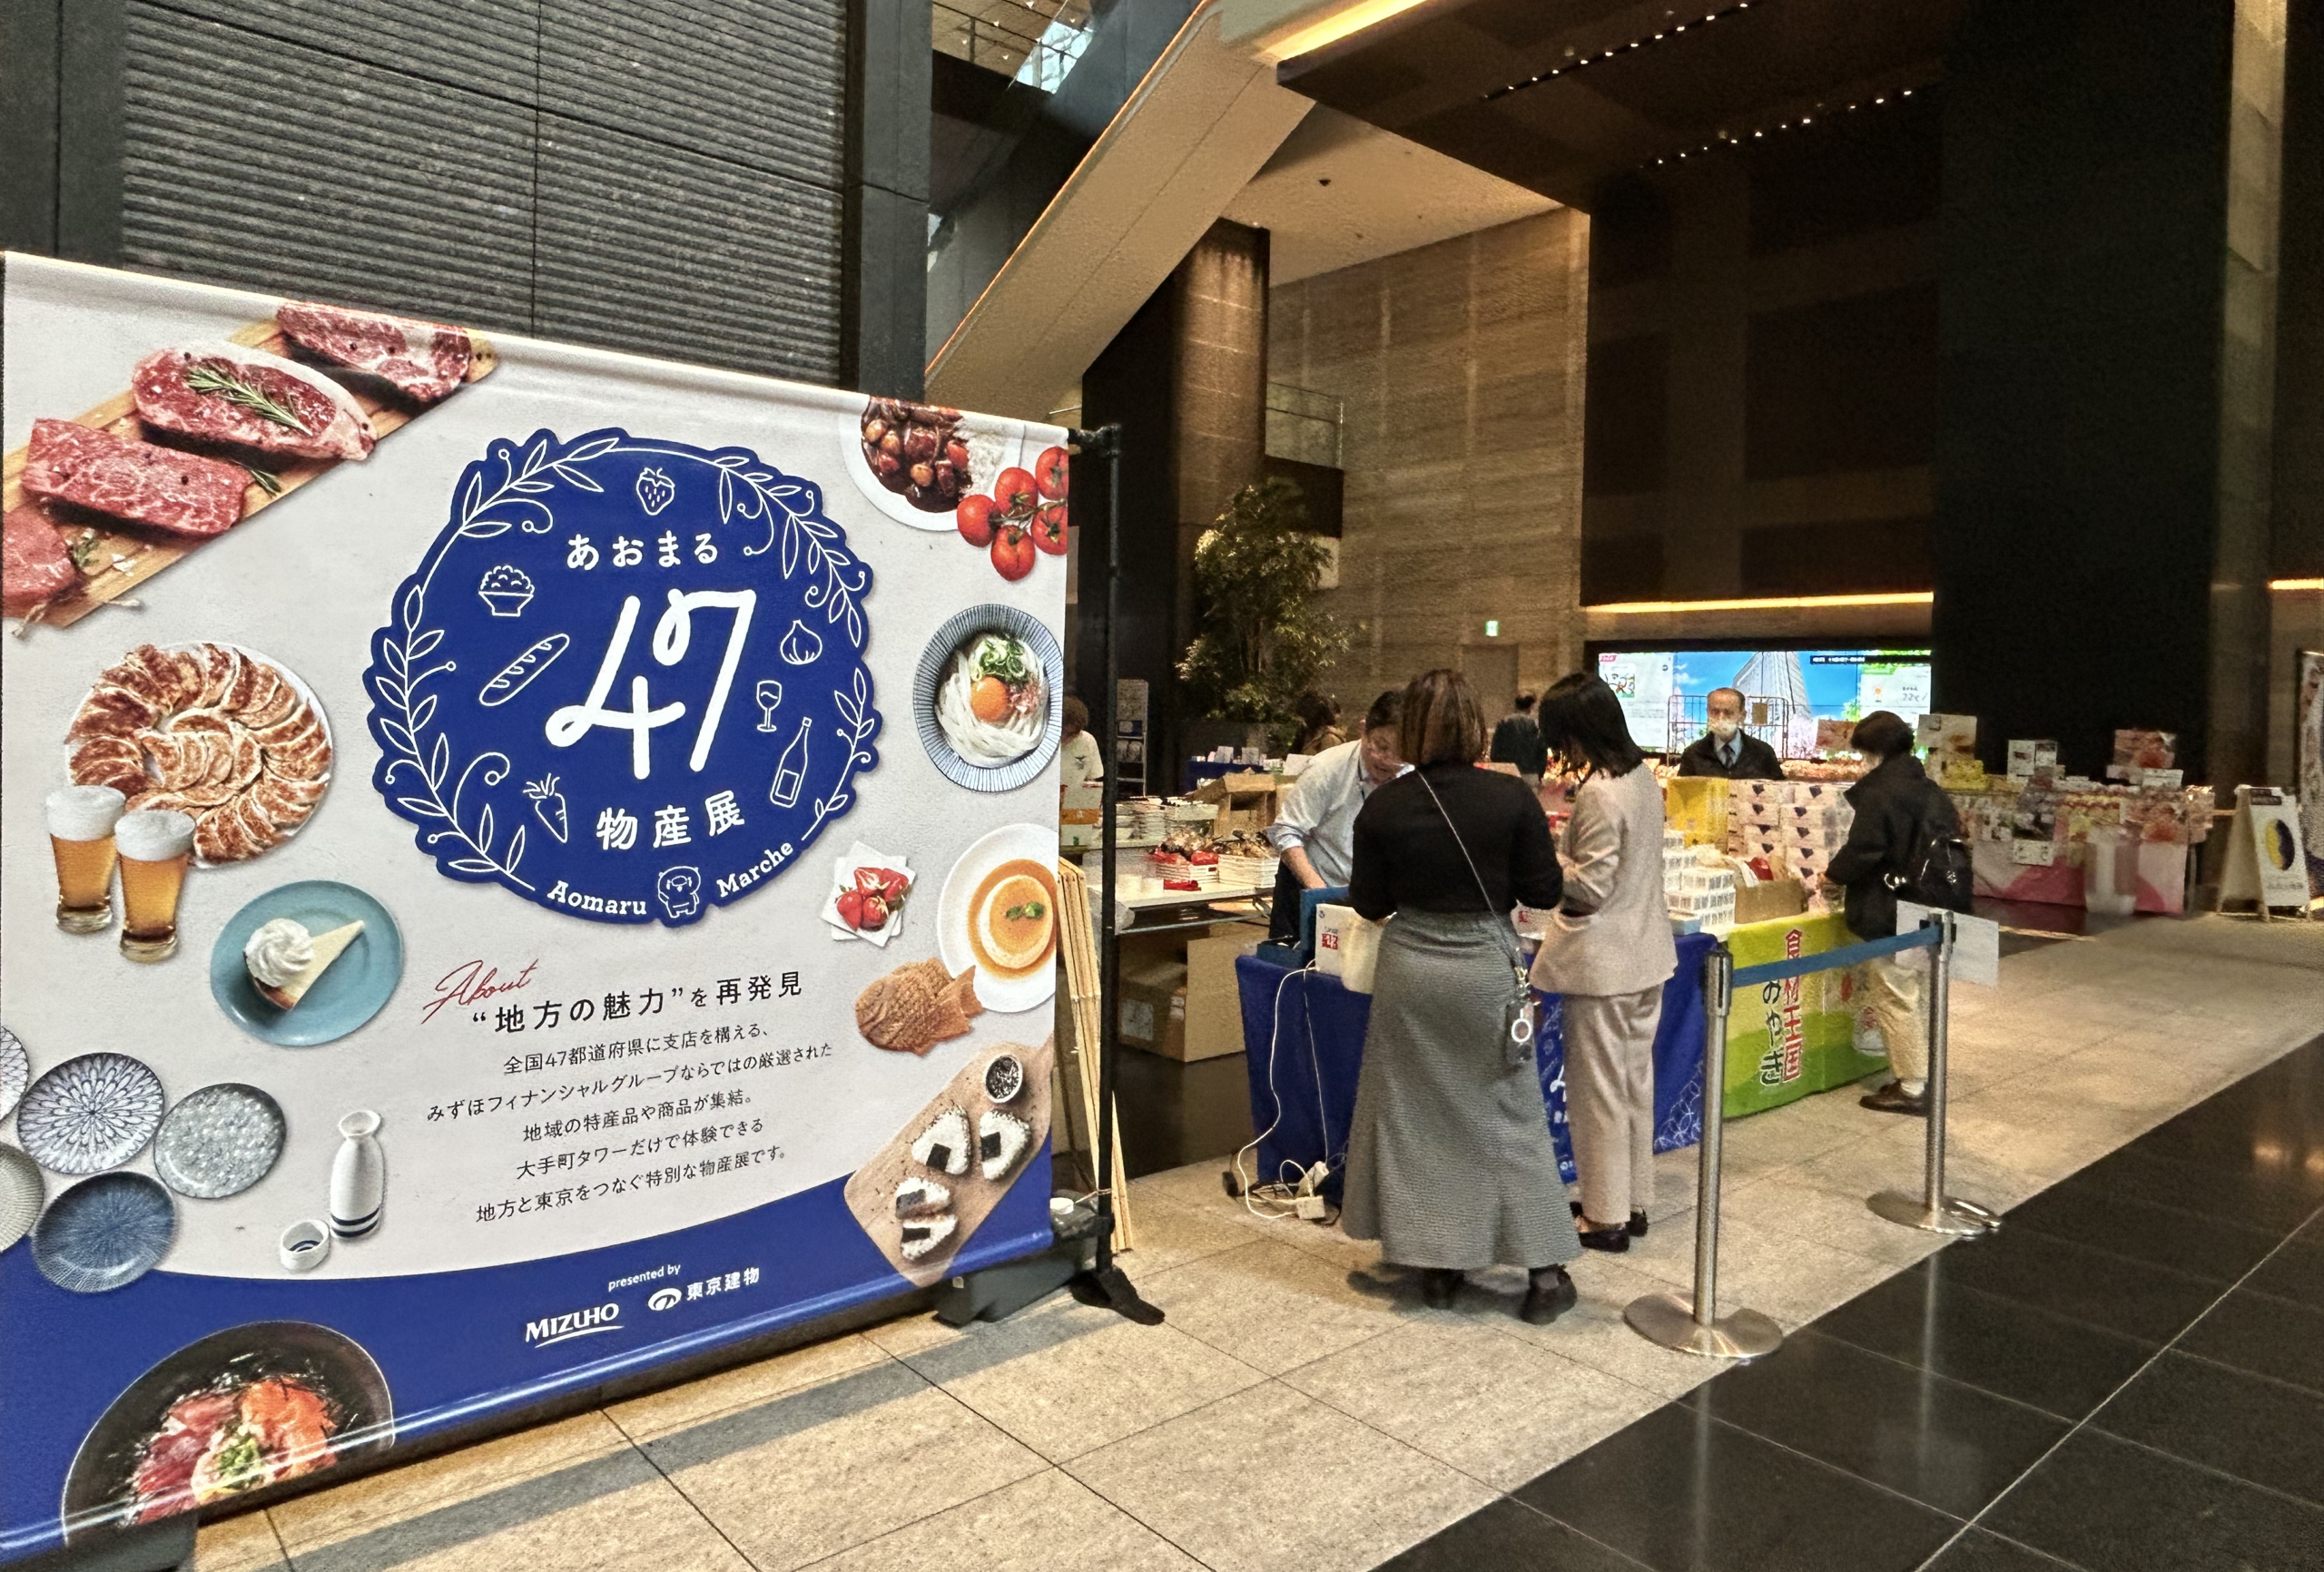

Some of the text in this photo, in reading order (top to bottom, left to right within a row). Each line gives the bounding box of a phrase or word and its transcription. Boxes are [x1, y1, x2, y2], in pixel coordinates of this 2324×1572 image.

[566, 529, 720, 571] あおまる
[545, 587, 757, 781] 47
[596, 790, 745, 850] 物産展
[547, 840, 794, 916] Aomaru Marche
[421, 958, 539, 1026] About
[426, 1042, 833, 1123] みずほフィナンシャルグループならではの厳選された
[522, 1088, 753, 1144] 地域の特産品や商品が集結。
[516, 1116, 764, 1181] 大手町タワーだけで体験できる
[476, 1144, 787, 1223] 地方と東京をつなぐ特別な物産展です。
[607, 1263, 681, 1292] presented by
[685, 1266, 761, 1302] 東京建物
[525, 1302, 621, 1343] MIZUHO
